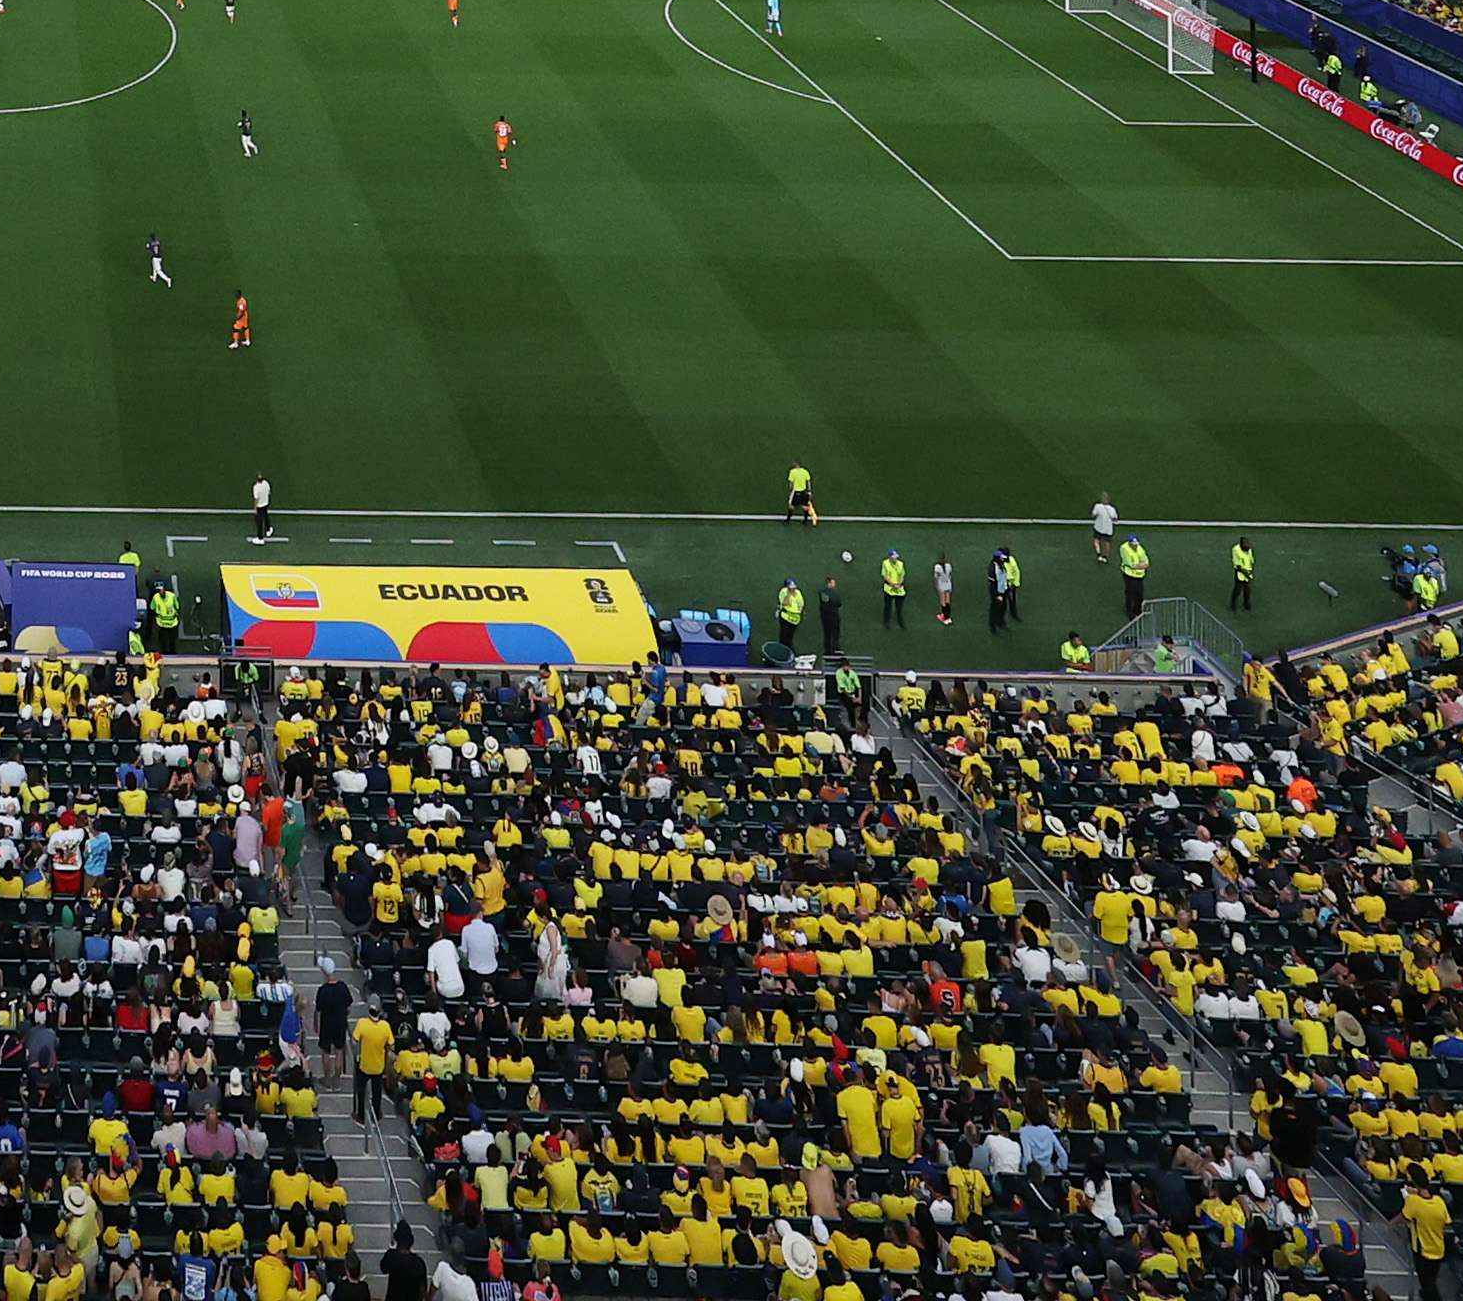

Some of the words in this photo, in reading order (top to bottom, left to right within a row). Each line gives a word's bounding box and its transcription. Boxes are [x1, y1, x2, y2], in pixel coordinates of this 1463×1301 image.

[1298, 78, 1344, 117] Coca-Cola
[1370, 118, 1422, 161] Coca-Cola
[21, 569, 41, 577] FIFA
[74, 570, 93, 578] CUP
[93, 571, 125, 579] 2026
[378, 583, 528, 602] ECUADOR
